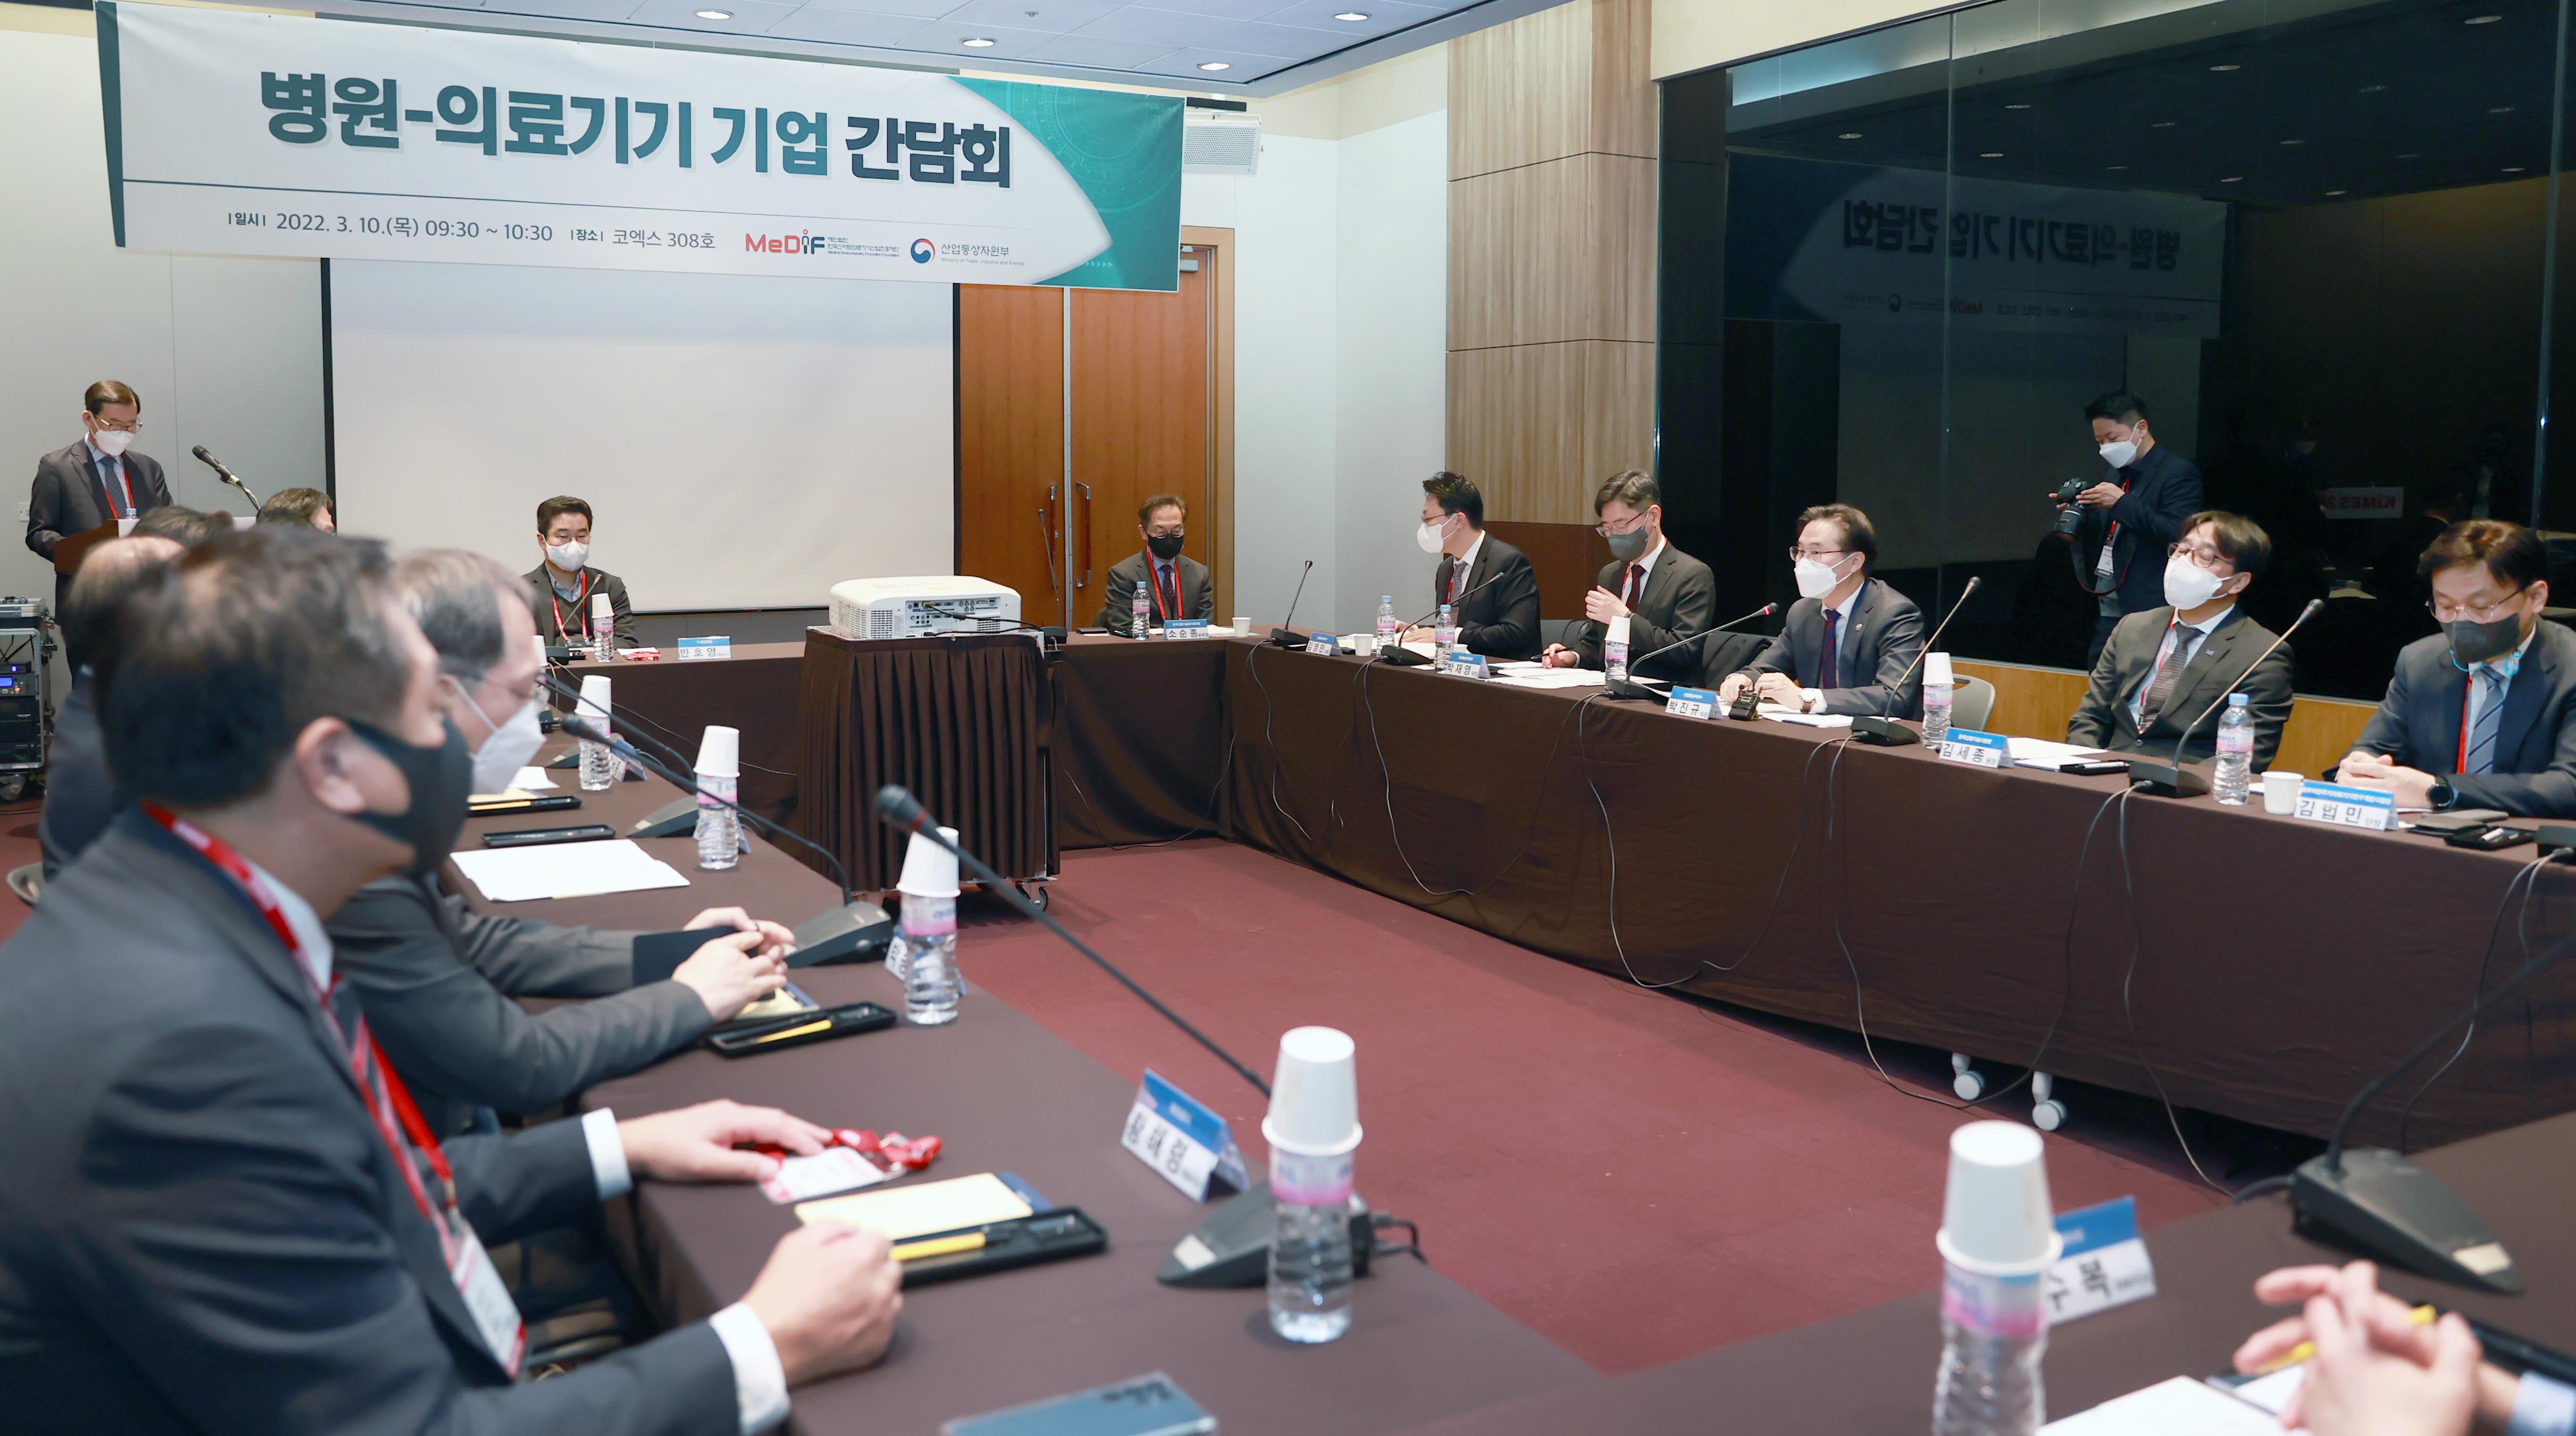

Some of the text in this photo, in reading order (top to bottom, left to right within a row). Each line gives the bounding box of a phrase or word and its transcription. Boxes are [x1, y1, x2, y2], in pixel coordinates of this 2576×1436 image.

[261, 70, 1010, 189] 병원-의료기기 기업 간담회
[276, 213, 330, 231] 2022.
[336, 216, 353, 232] 3.
[359, 217, 419, 237] 10.(목)
[425, 220, 480, 238] 09:30
[504, 223, 553, 241] 10:30
[613, 229, 662, 248] 코엑스
[667, 232, 716, 249] 308호
[941, 244, 1009, 257] 산업통상자원부
[1168, 629, 1198, 638] 소순종
[680, 647, 716, 658] 반호영
[1669, 700, 1700, 716] 박진규
[1943, 744, 1985, 763] 김세종
[2299, 800, 2381, 828] 김법민 단장
